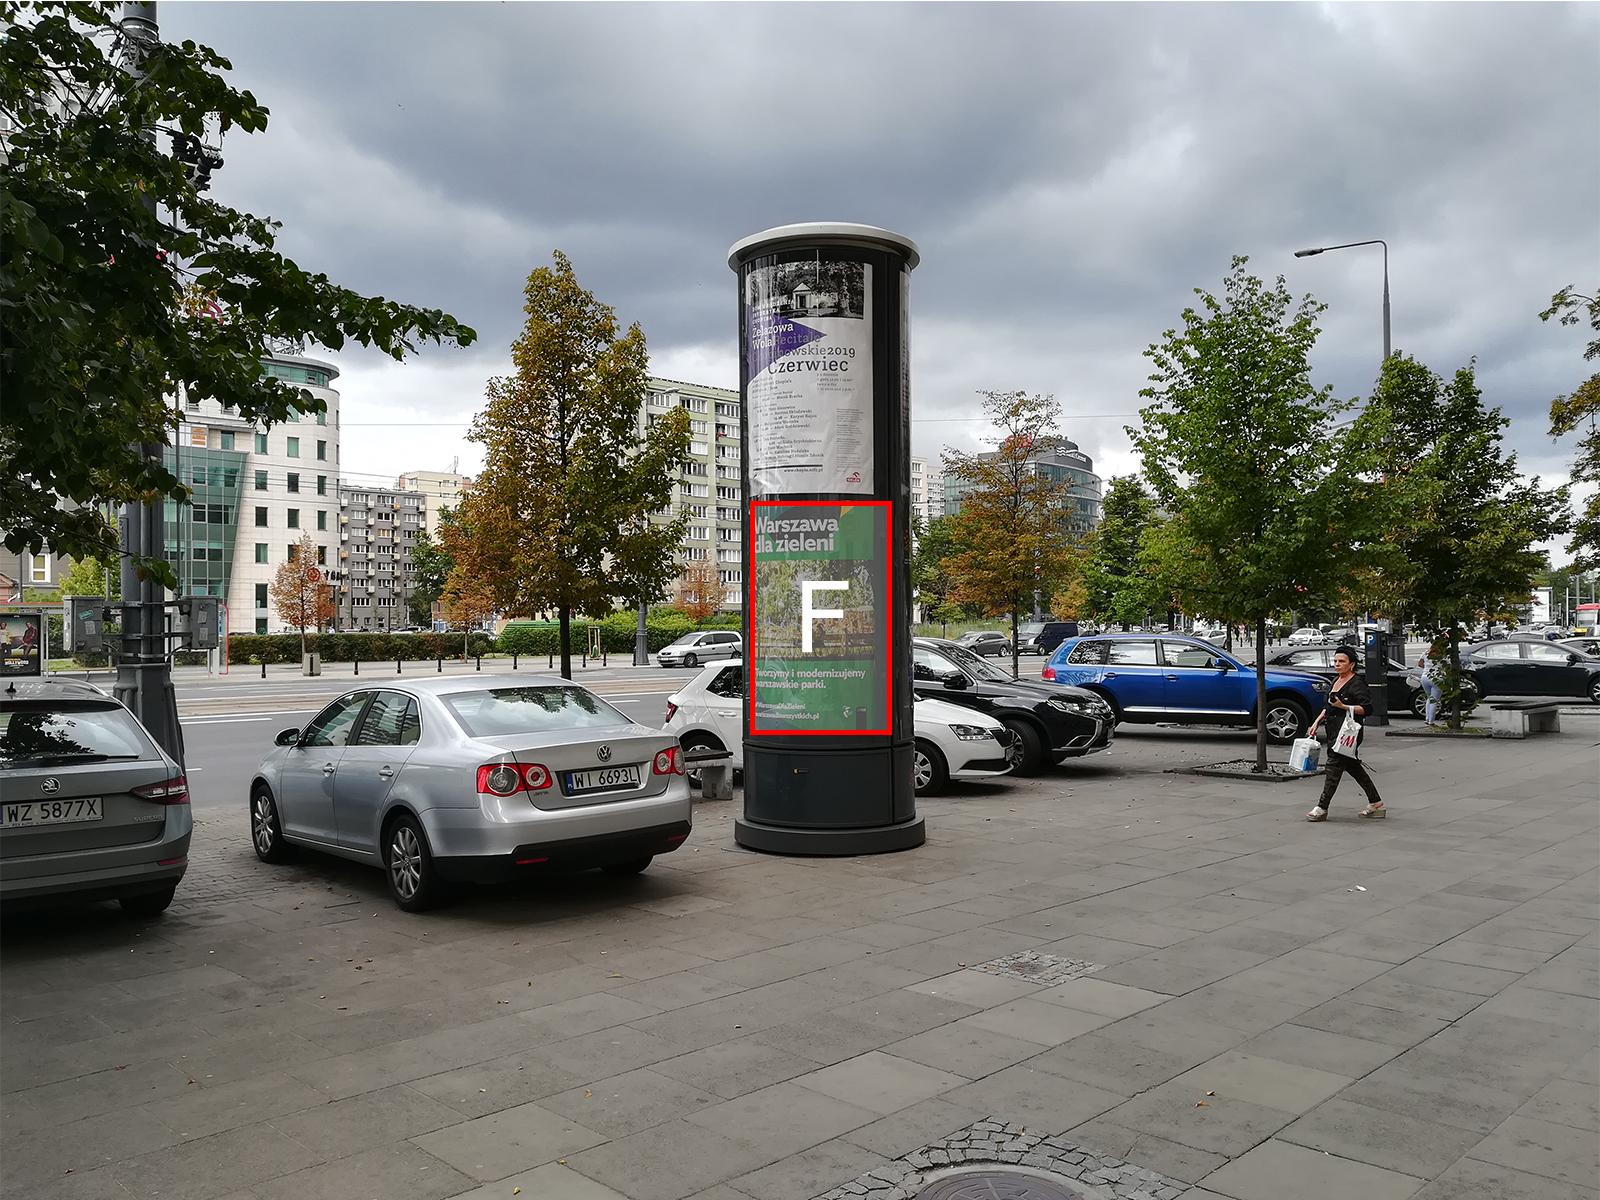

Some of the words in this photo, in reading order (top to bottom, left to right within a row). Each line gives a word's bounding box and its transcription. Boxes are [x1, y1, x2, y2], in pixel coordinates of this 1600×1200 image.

[755, 516, 839, 534] Warszawa
[755, 535, 773, 553] dla
[775, 533, 834, 552] zieleni
[796, 669, 866, 680] modernizujemy
[801, 680, 827, 690] parki.
[575, 774, 592, 788] WI
[598, 769, 637, 785] 6693L
[7, 804, 33, 823] WZ
[40, 799, 97, 820] 5877X
